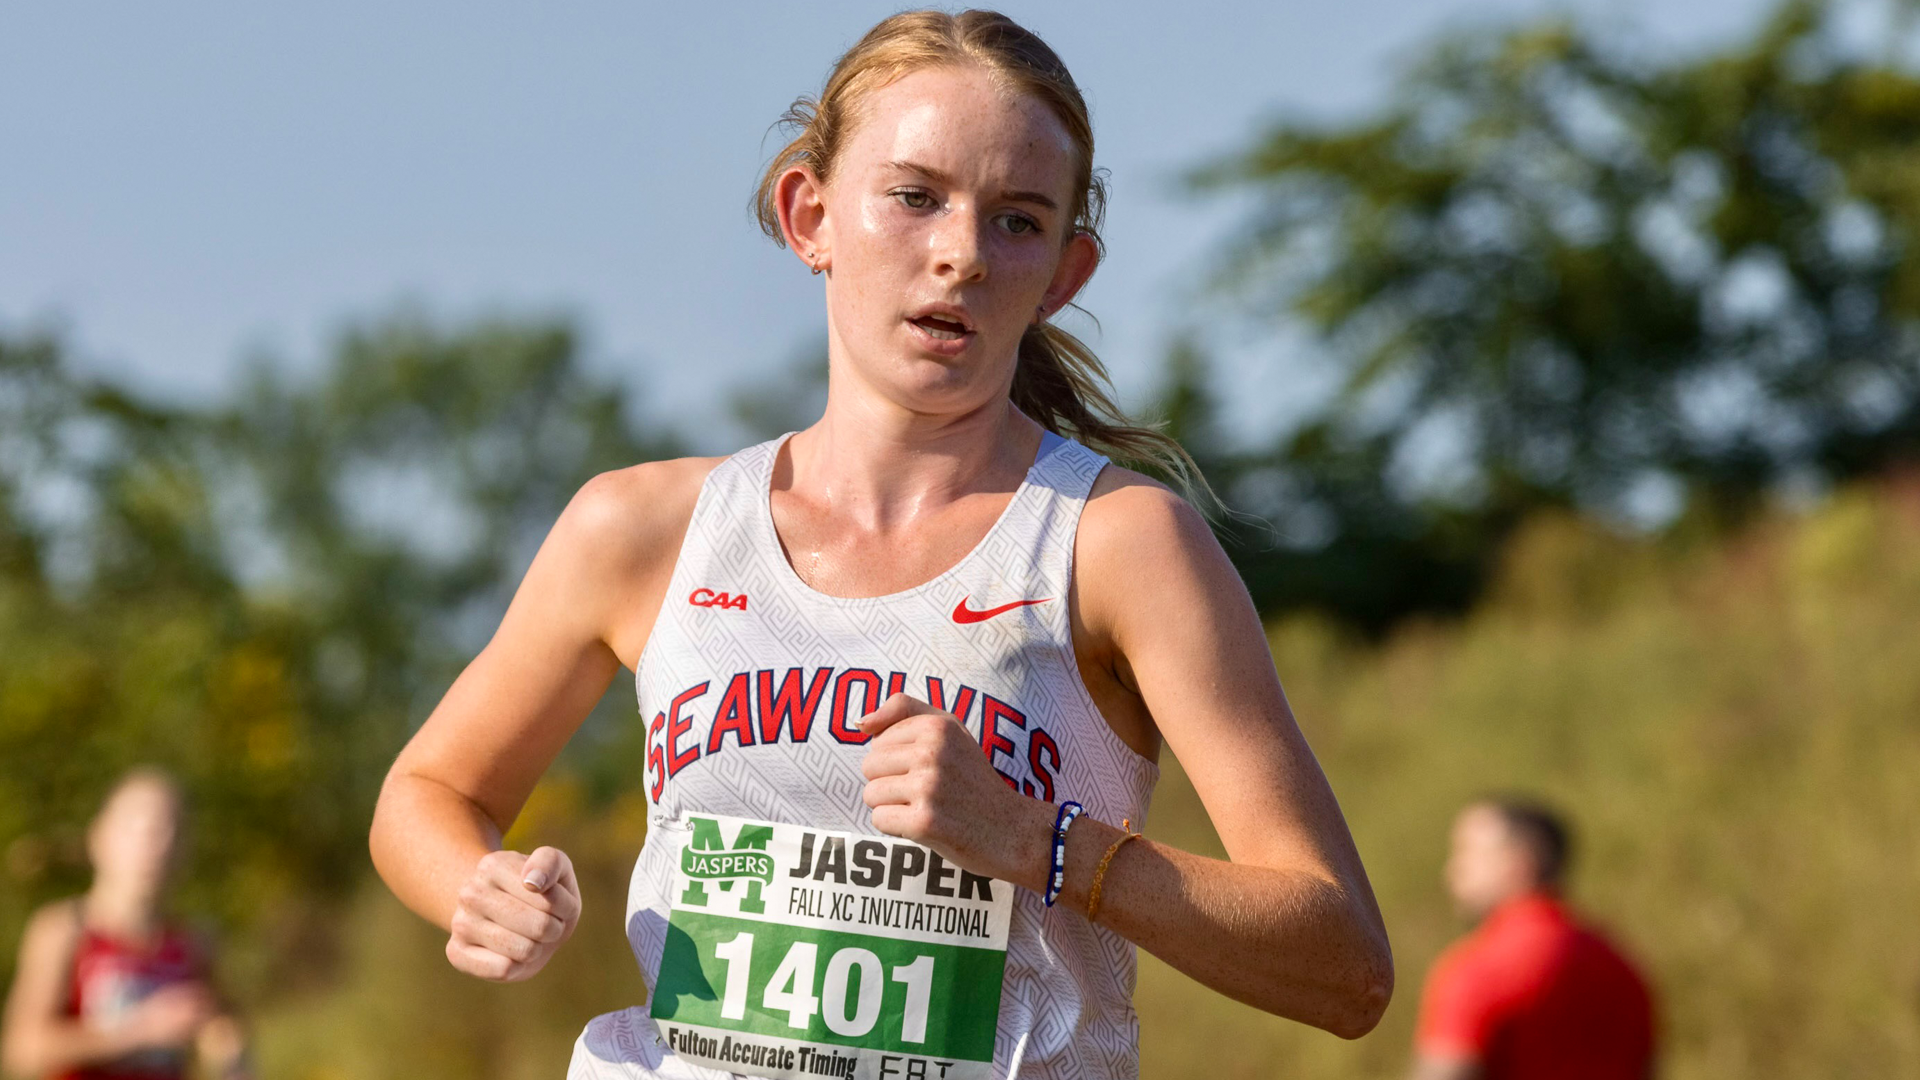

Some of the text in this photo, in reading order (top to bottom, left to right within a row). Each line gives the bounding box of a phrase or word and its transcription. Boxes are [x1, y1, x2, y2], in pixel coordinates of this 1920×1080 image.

[689, 588, 748, 611] CAA
[647, 667, 1061, 804] SEAWOVES
[681, 816, 774, 915] M
[687, 855, 768, 876] JASPERS
[788, 886, 990, 939] FALL XC INVITATIONAL
[715, 932, 935, 1045] 1401
[668, 1027, 858, 1080] Fulton Accurate Timing
